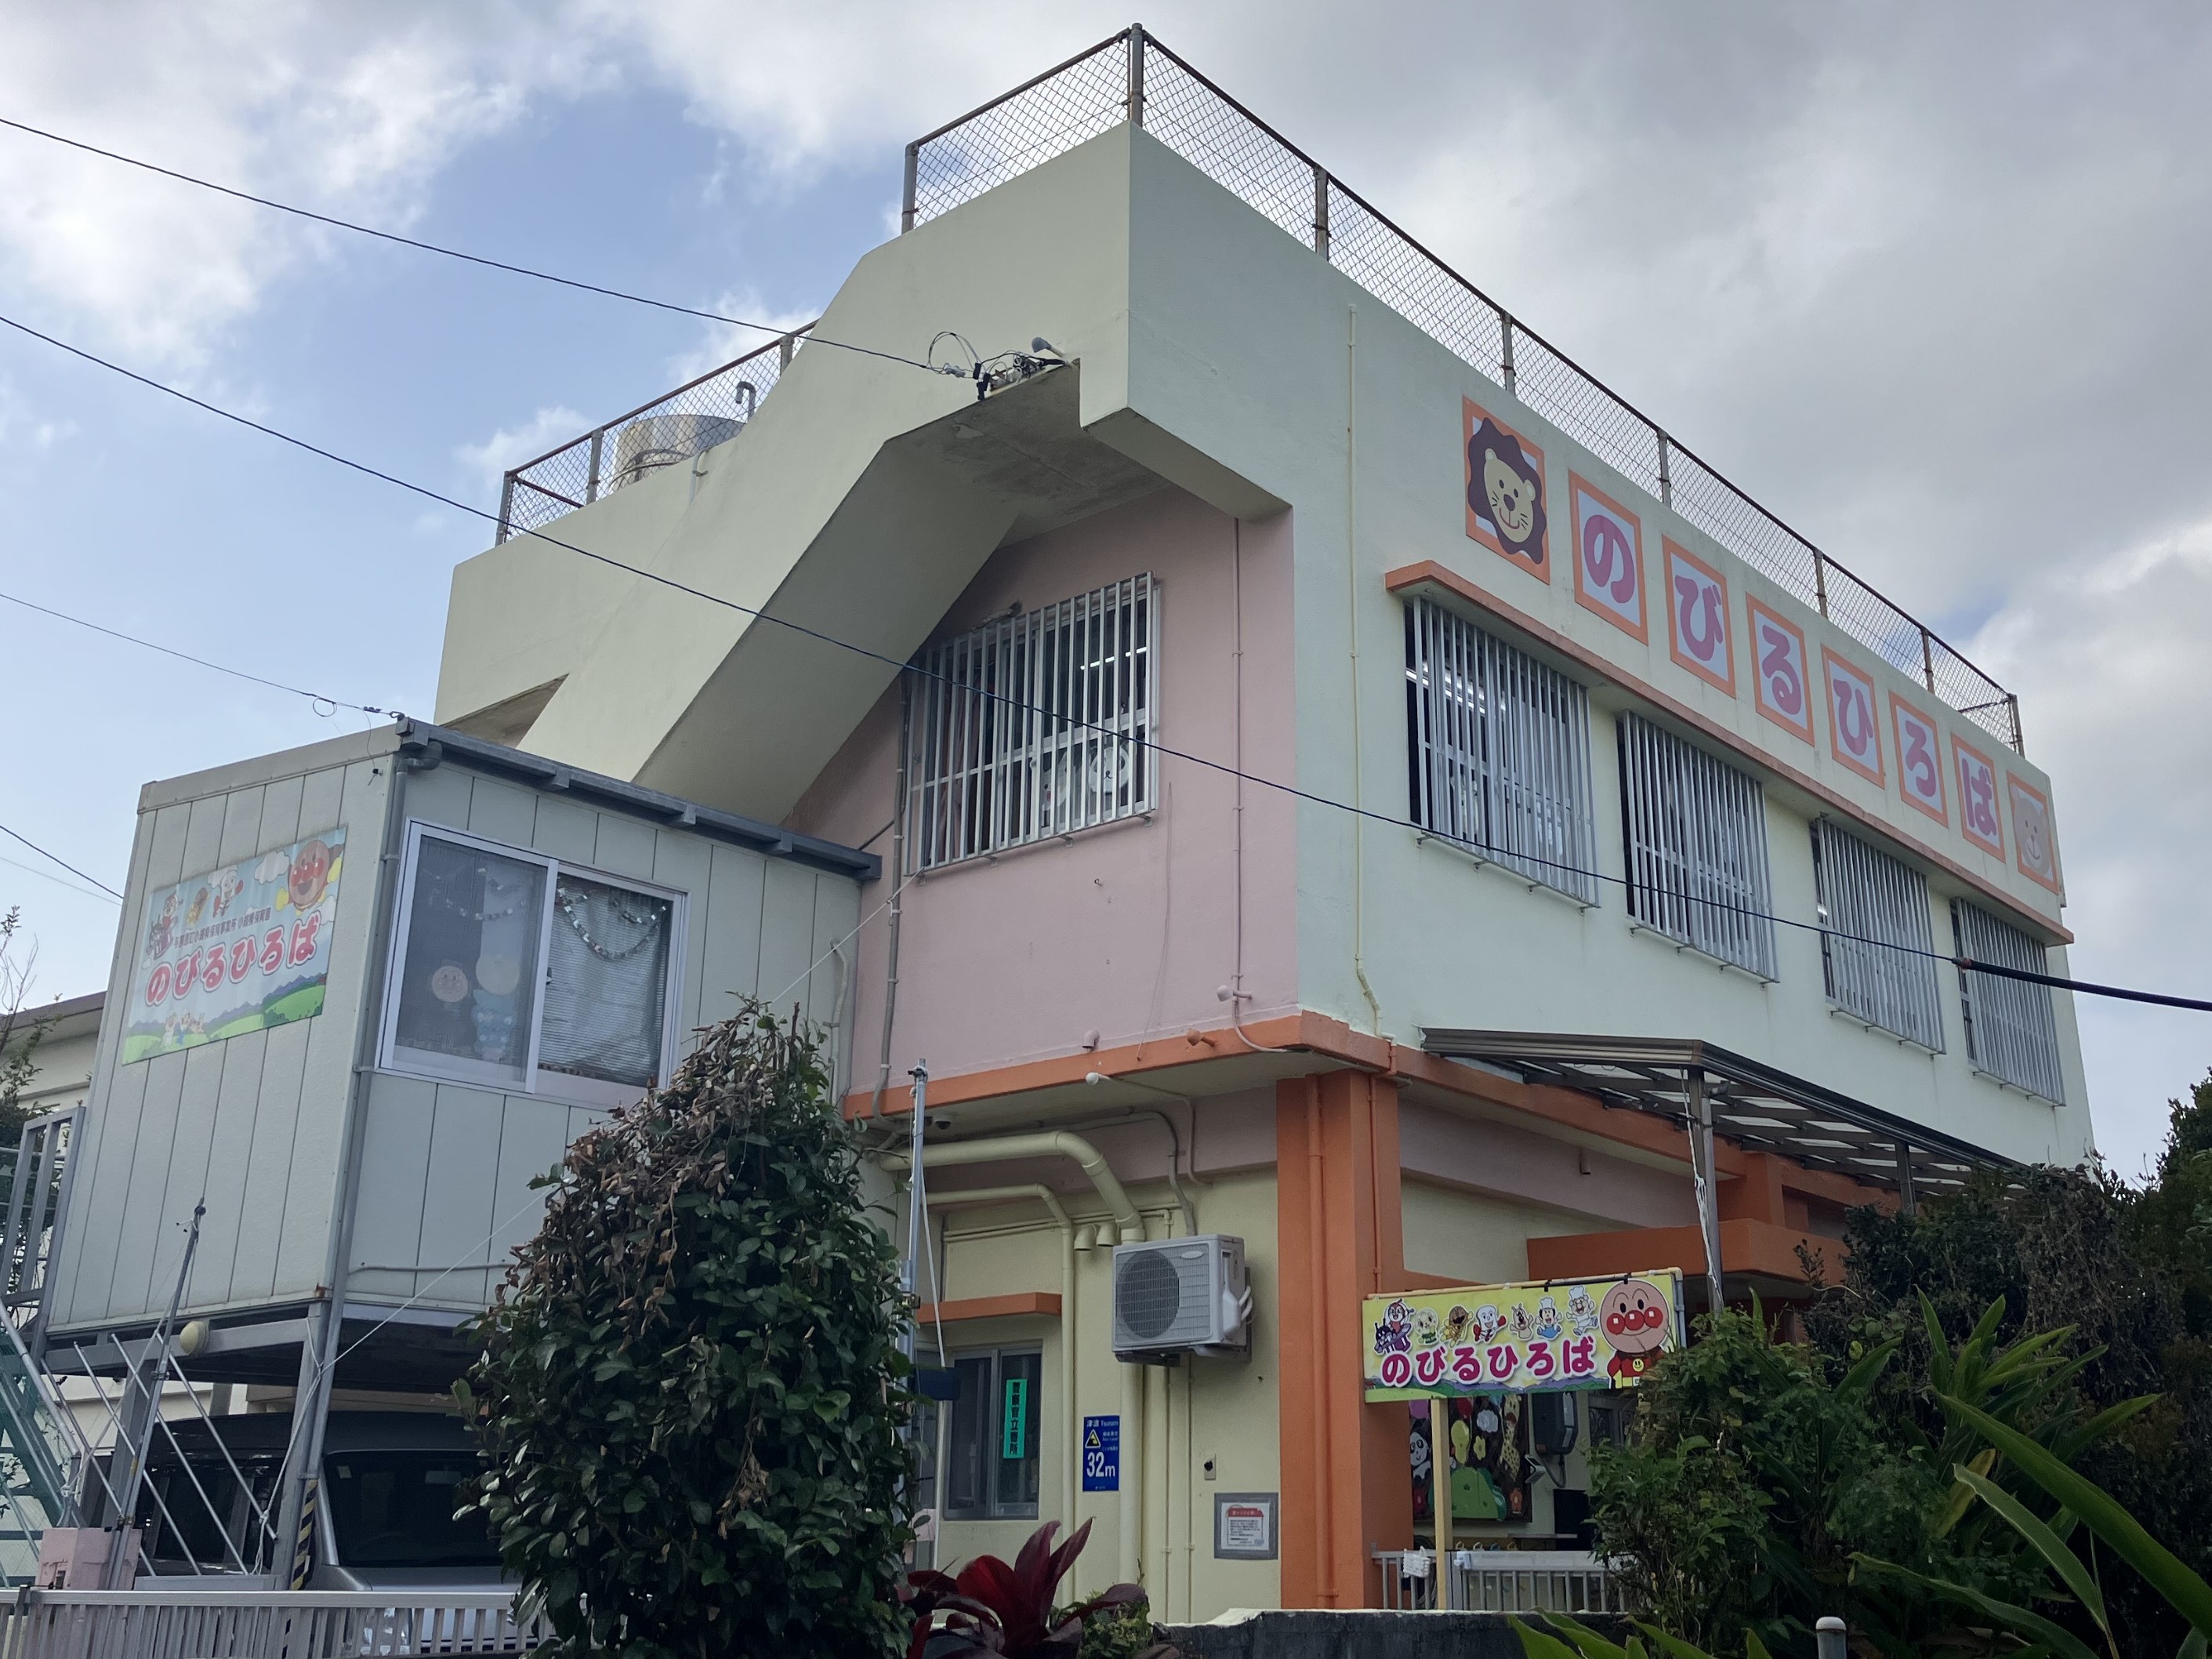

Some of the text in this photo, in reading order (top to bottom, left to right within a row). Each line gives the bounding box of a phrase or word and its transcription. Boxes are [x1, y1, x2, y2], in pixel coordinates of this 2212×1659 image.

[1583, 514, 1996, 837] のびるひろば
[146, 912, 320, 1005] のびるひろば
[1380, 1336, 1596, 1385] のびるひろば
[1086, 1451, 1115, 1477] 32m
